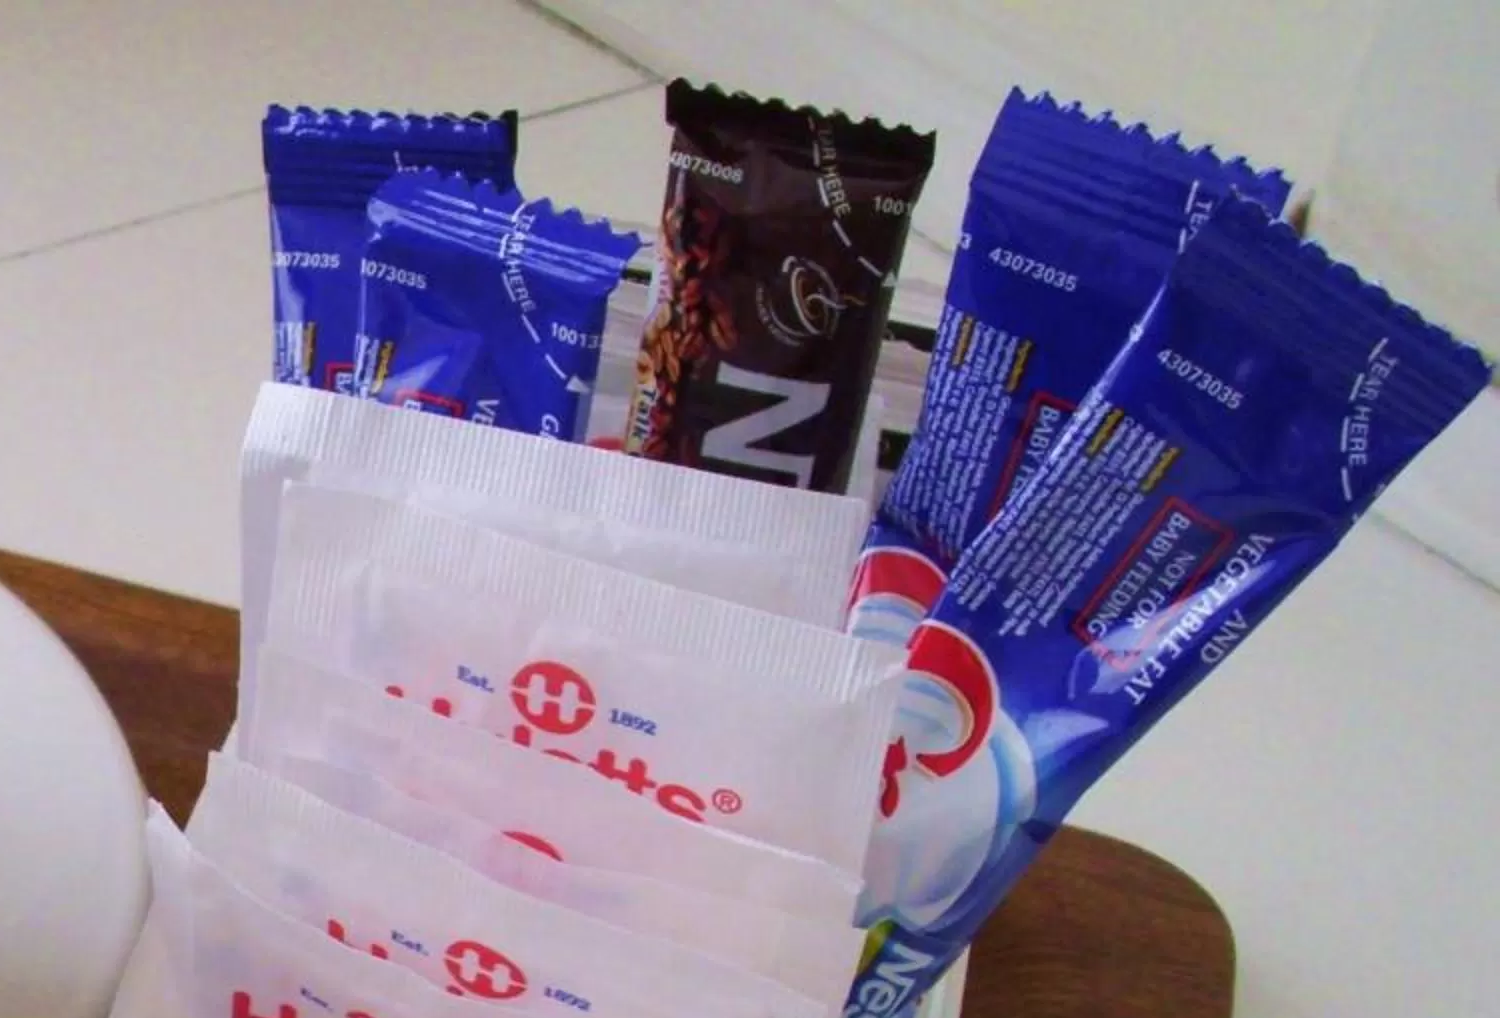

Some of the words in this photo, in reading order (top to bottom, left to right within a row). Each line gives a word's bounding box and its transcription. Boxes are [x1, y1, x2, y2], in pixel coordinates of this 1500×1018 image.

[505, 259, 538, 313] HERE
[988, 246, 1079, 292] 43073035
[1156, 348, 1245, 411] 43073035
[1358, 350, 1399, 402] TEAR
[1028, 404, 1061, 459] BABY
[1348, 405, 1373, 467] HERE
[1145, 511, 1192, 564] BABY
[1156, 549, 1197, 592] NOT
[1158, 532, 1276, 660] VEGETABLE
[1087, 560, 1155, 638] FEEDING
[1126, 587, 1166, 630] FOR
[1200, 608, 1250, 664] AND
[456, 664, 496, 695] Est.
[608, 706, 657, 737] 1892
[1122, 657, 1168, 706] FAT
